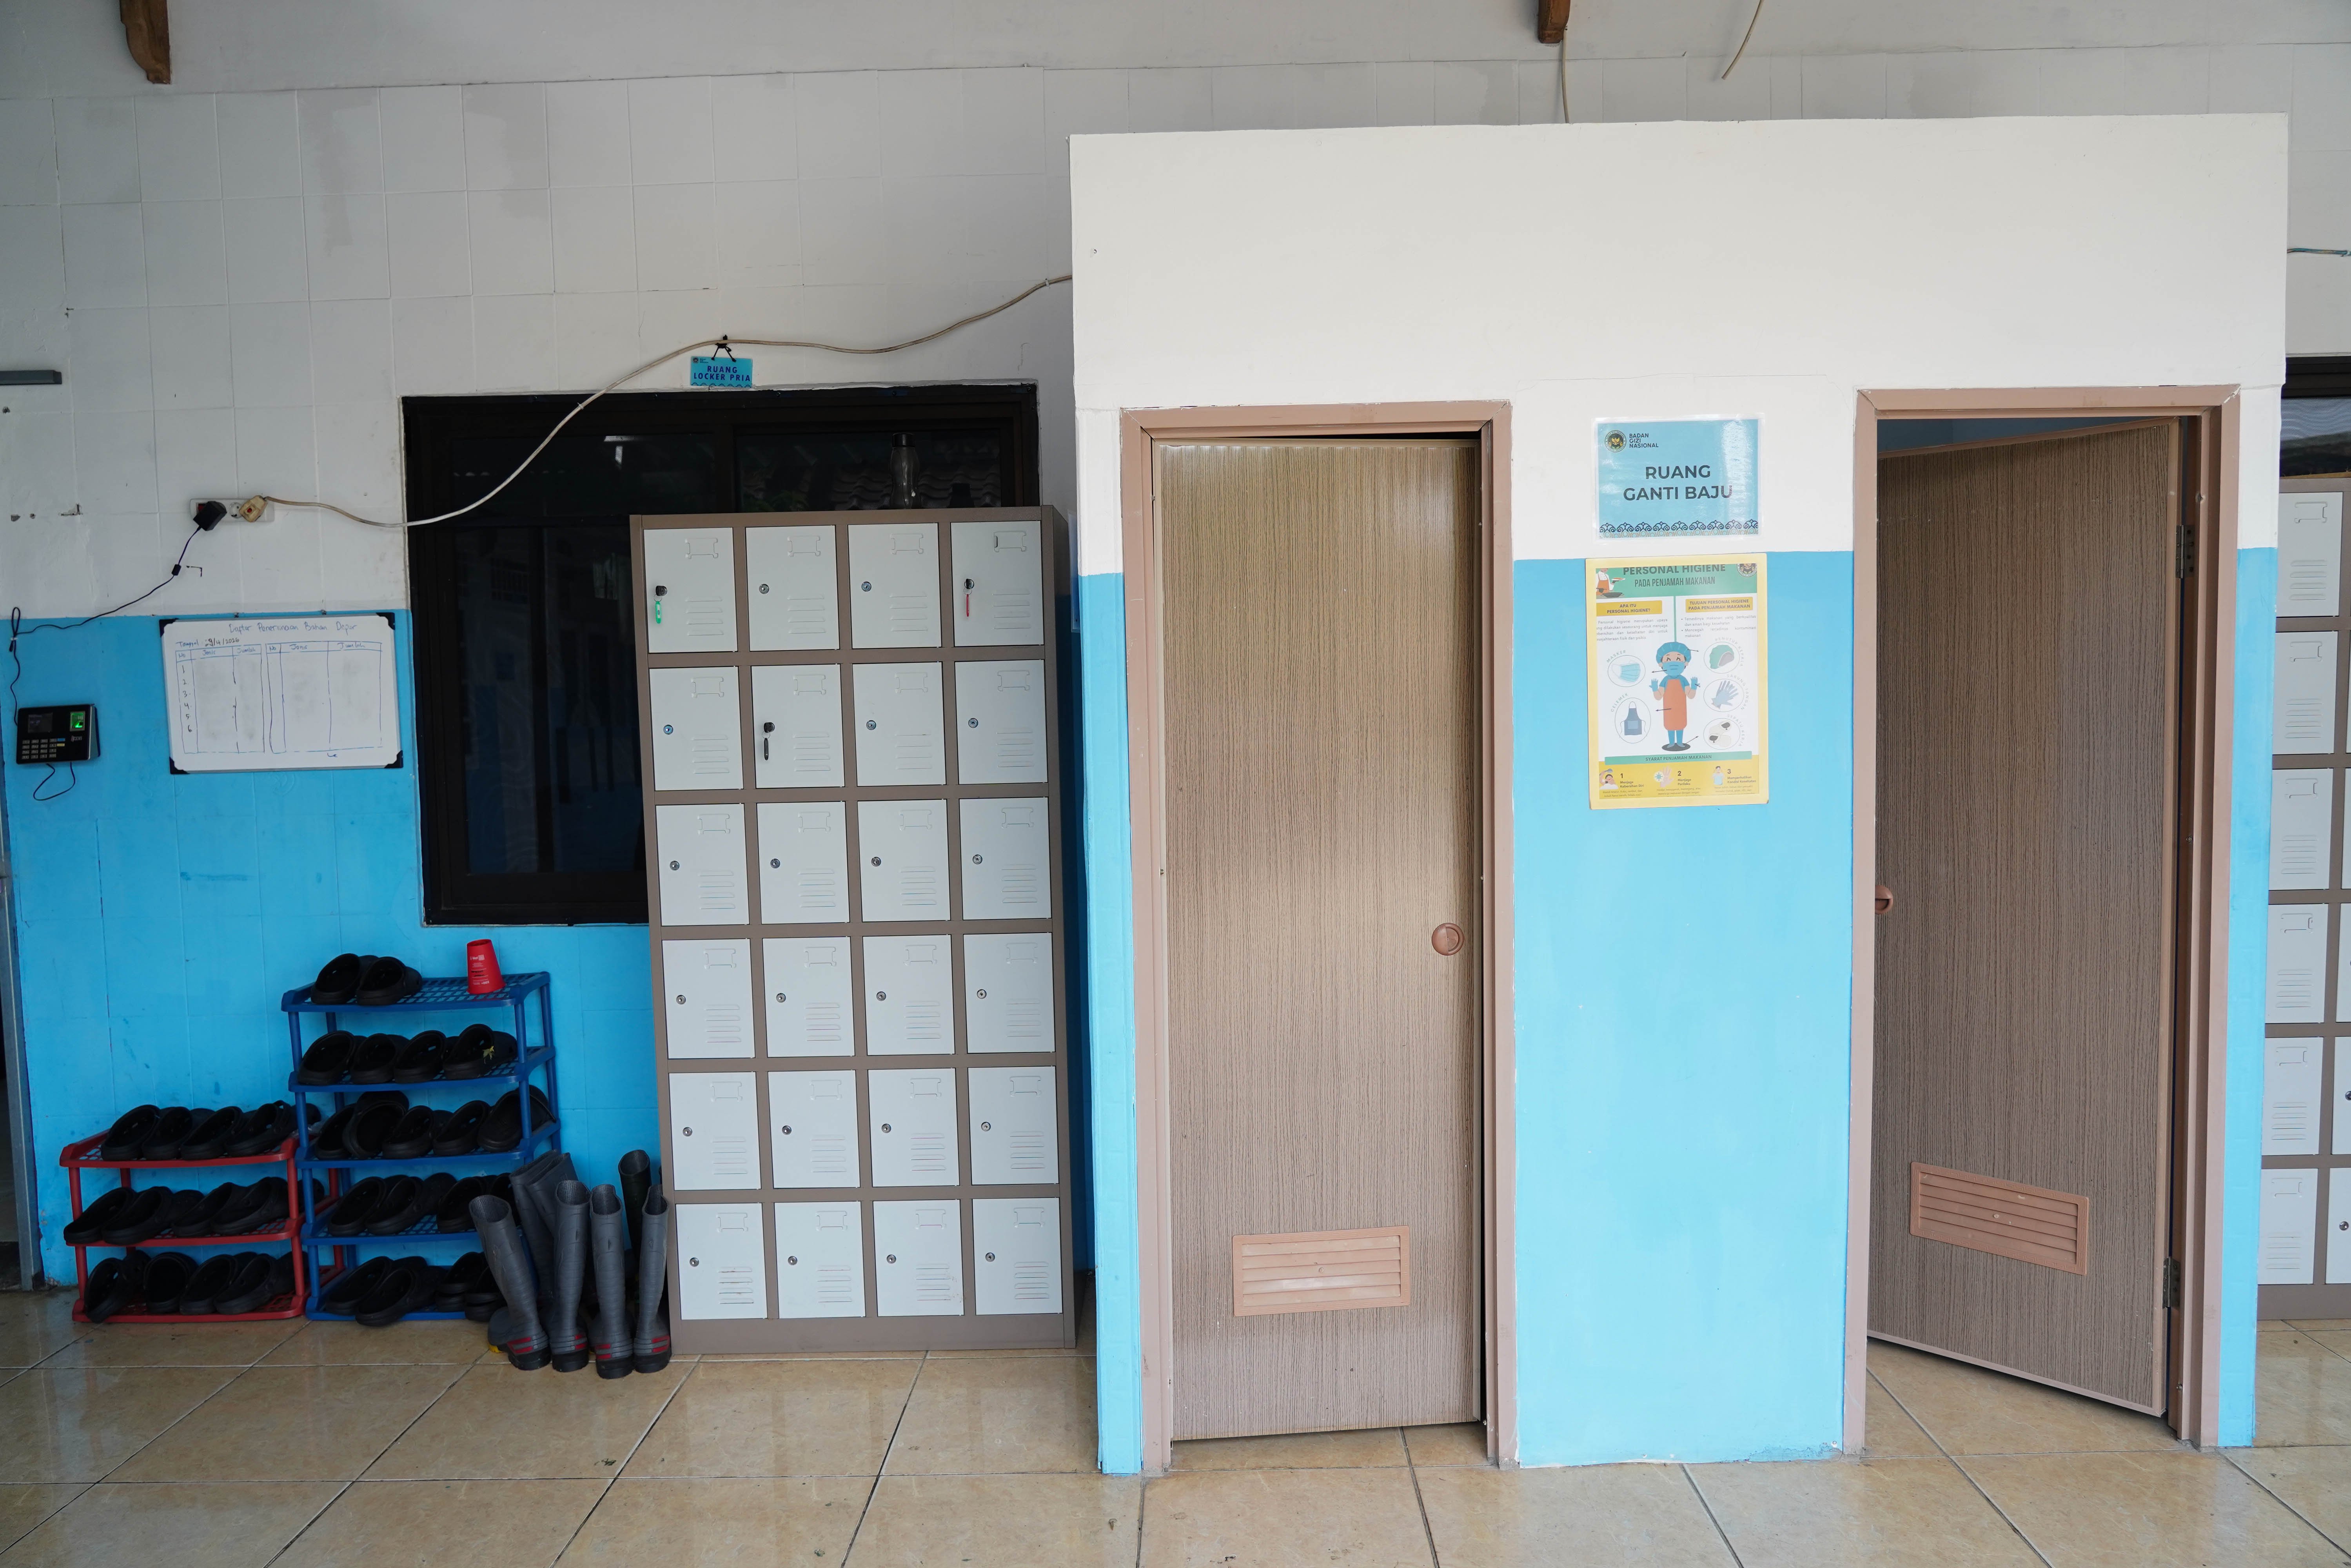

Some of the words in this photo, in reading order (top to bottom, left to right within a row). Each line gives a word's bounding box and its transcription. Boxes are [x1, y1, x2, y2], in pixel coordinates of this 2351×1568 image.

[1645, 465, 1710, 479] RUANG
[1623, 487, 1678, 501] GANTI
[1685, 485, 1732, 499] BAJU
[1623, 566, 1679, 575] PERSONAL
[1682, 564, 1726, 573] HIGIENE
[1635, 579, 1650, 587] PADA
[1652, 578, 1684, 586] PENJAMAH
[1685, 576, 1716, 585] MAKANAN
[1606, 650, 1626, 663] MASKER
[1611, 693, 1628, 712] CELEMEK
